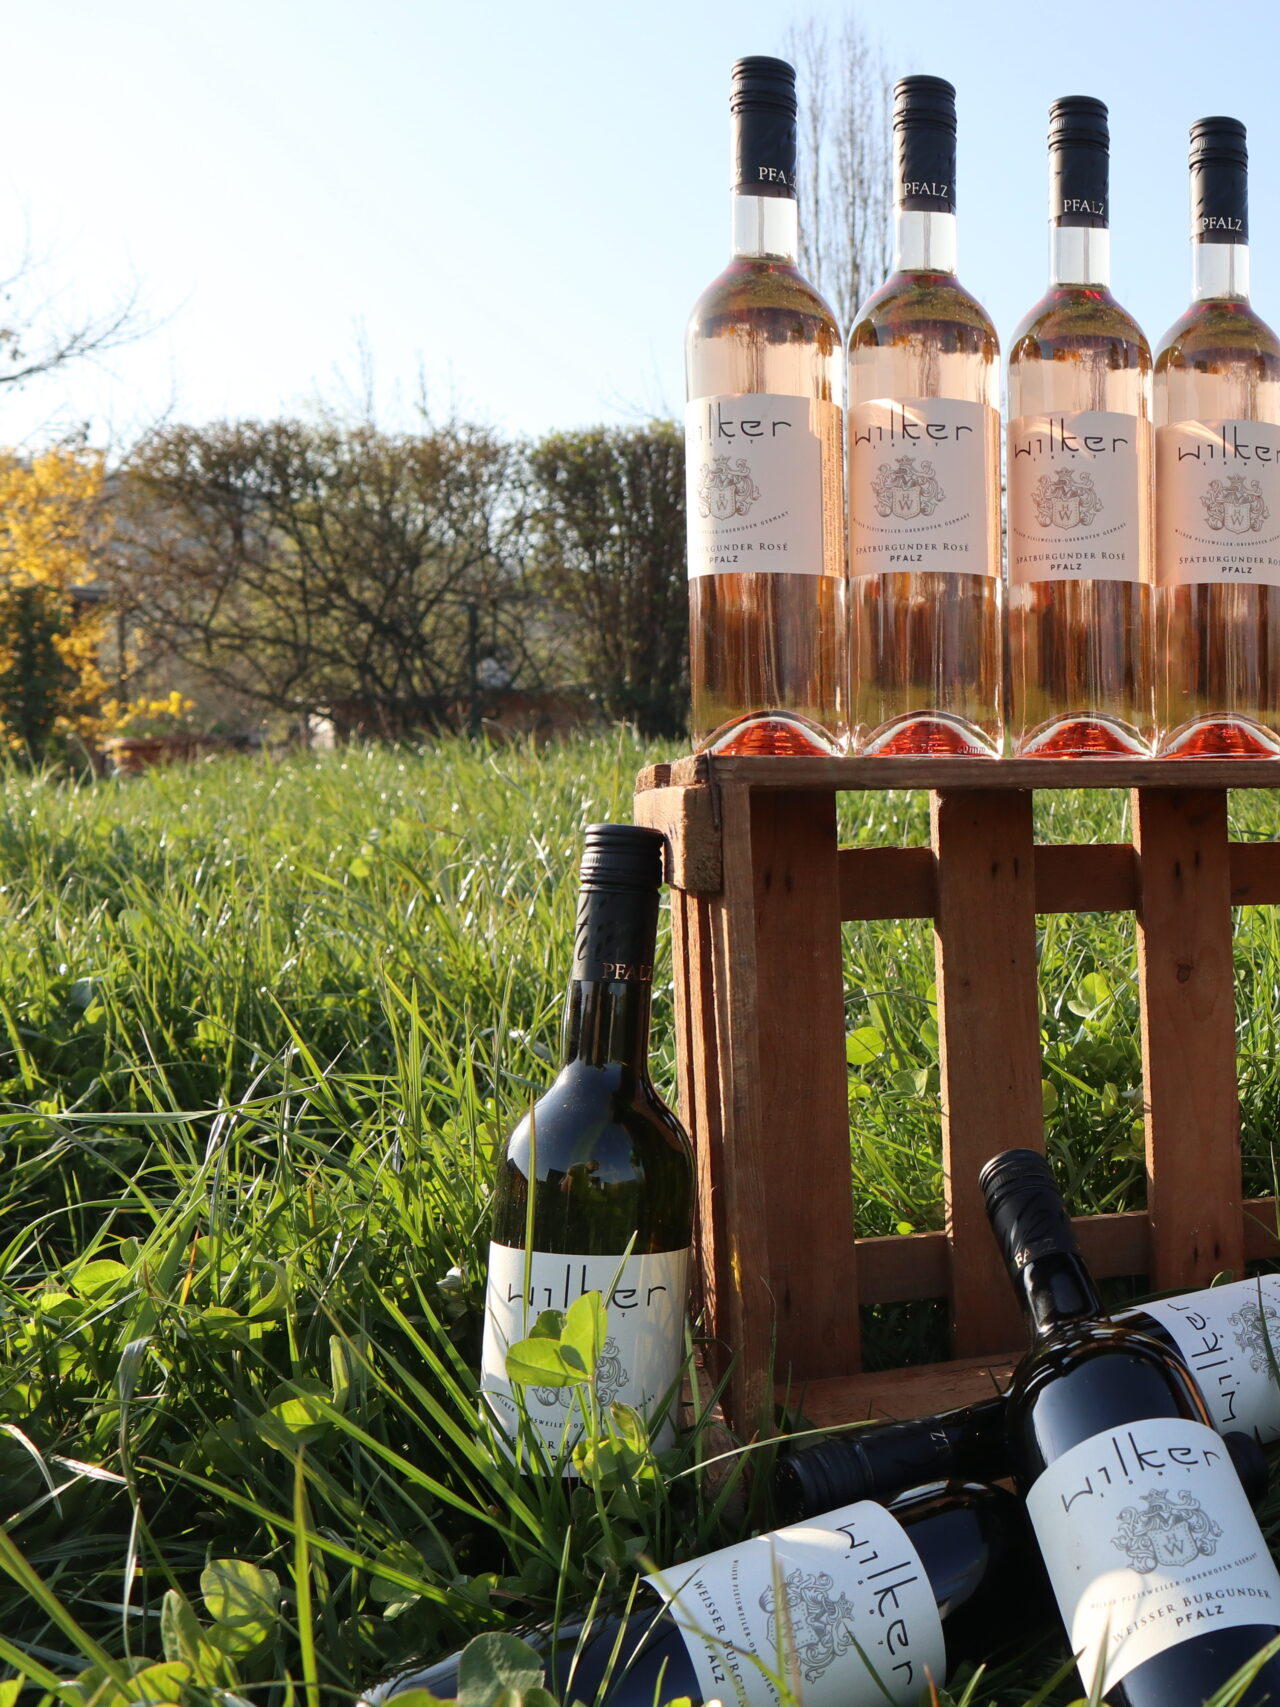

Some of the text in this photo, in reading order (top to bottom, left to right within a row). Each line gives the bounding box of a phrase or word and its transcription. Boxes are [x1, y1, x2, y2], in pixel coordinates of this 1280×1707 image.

[904, 182, 948, 198] PFALZ
[1063, 199, 1104, 215] PFALZ
[1202, 217, 1242, 231] PFALZ
[854, 404, 973, 447] wilker
[1015, 418, 1128, 459] wilker
[709, 555, 739, 564] PFALZ
[889, 554, 923, 562] PFALZ
[1050, 563, 1082, 571] PFALZ
[1221, 566, 1253, 574] PFALZ
[1167, 1303, 1237, 1422] wilker
[1060, 1431, 1221, 1513] wilker
[693, 1580, 726, 1635] WEISSER
[836, 1522, 919, 1686] wilker
[1113, 1587, 1272, 1644] WEISSER BURGUNDER
[1176, 1604, 1225, 1627] PFALZ
[702, 1637, 726, 1685] FALZ
